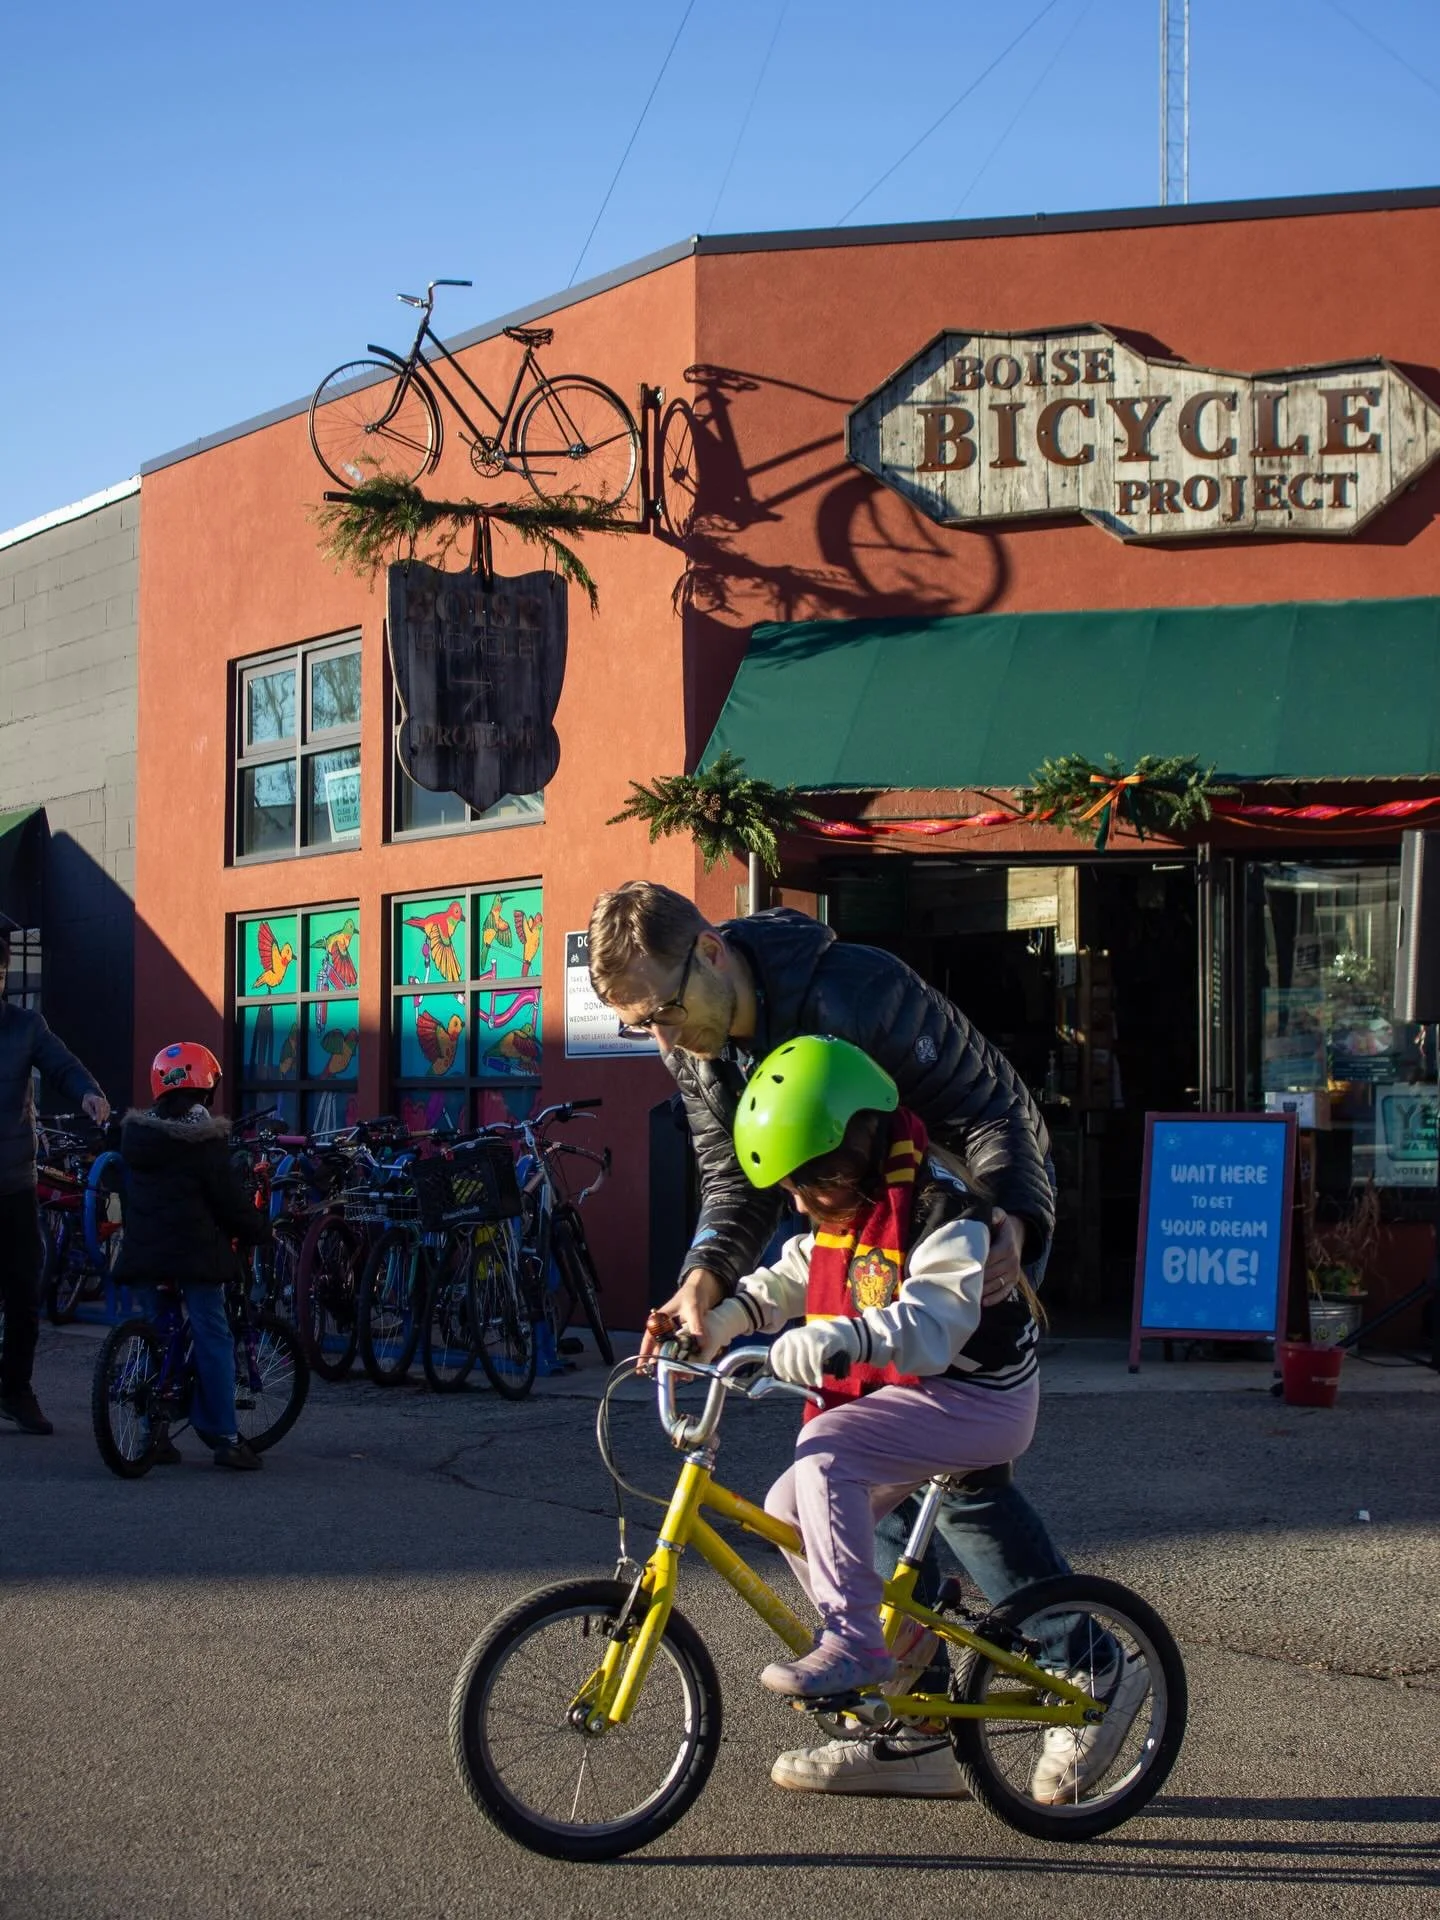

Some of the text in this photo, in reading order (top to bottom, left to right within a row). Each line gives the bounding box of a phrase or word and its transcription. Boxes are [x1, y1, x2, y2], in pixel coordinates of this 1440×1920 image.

[950, 346, 1115, 391] BOISE
[916, 386, 1383, 472] BICYCLE
[1116, 472, 1358, 522] PROJECT
[584, 1002, 604, 1010] DONA
[569, 1015, 599, 1023] WEDNESDAY
[1171, 1164, 1268, 1184] WAIT HERE
[1395, 1167, 1435, 1175] VOTE BY
[1191, 1195, 1233, 1209] TO GET
[1160, 1219, 1268, 1238] YOUR DREAM
[1162, 1246, 1260, 1286] BIKE!
